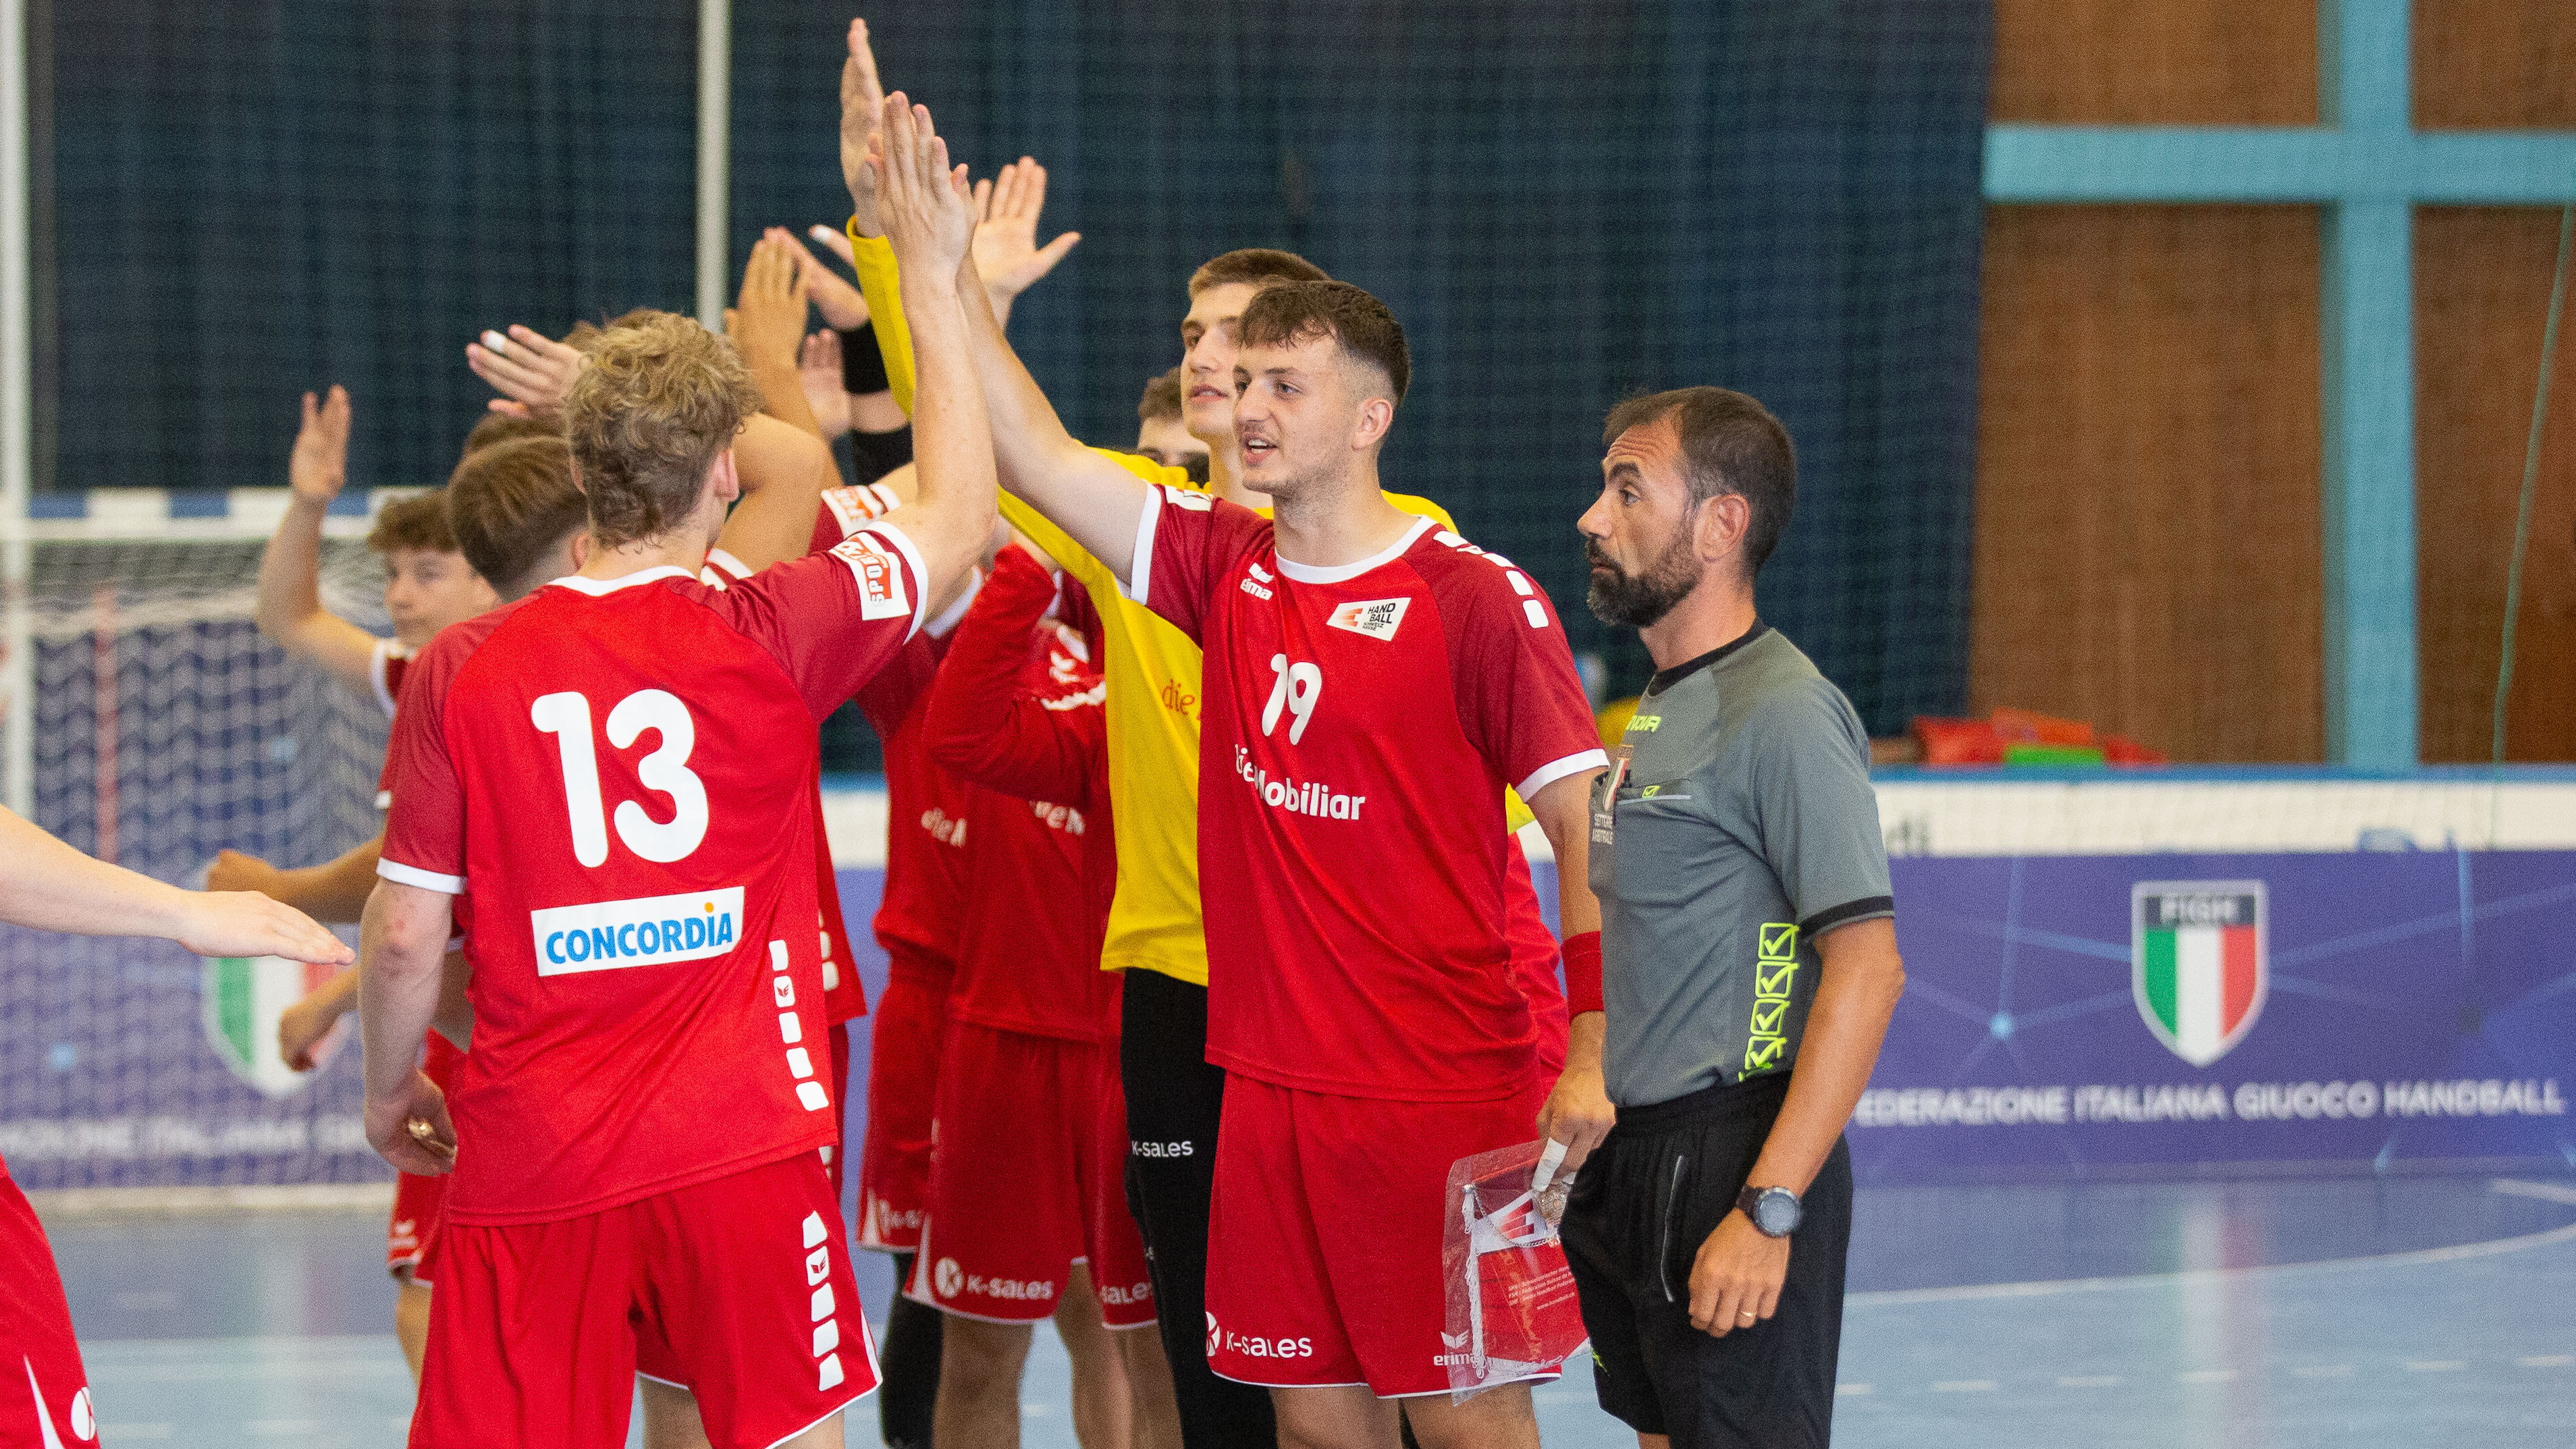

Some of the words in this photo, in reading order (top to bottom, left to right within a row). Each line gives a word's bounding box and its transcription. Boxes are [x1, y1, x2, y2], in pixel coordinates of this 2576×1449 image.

[1368, 603, 1396, 614] HAND
[1369, 613, 1393, 624] BALL
[1262, 653, 1322, 745] 19
[531, 688, 709, 868] 13
[545, 902, 733, 964] CONCORDIA
[1854, 1086, 2068, 1127] EDERAZIONE
[2074, 1084, 2227, 1124] ITALIANA
[2233, 1081, 2380, 1120] GIUOCO
[2384, 1078, 2563, 1118] HANDBALL
[1226, 1330, 1313, 1359] K-sales
